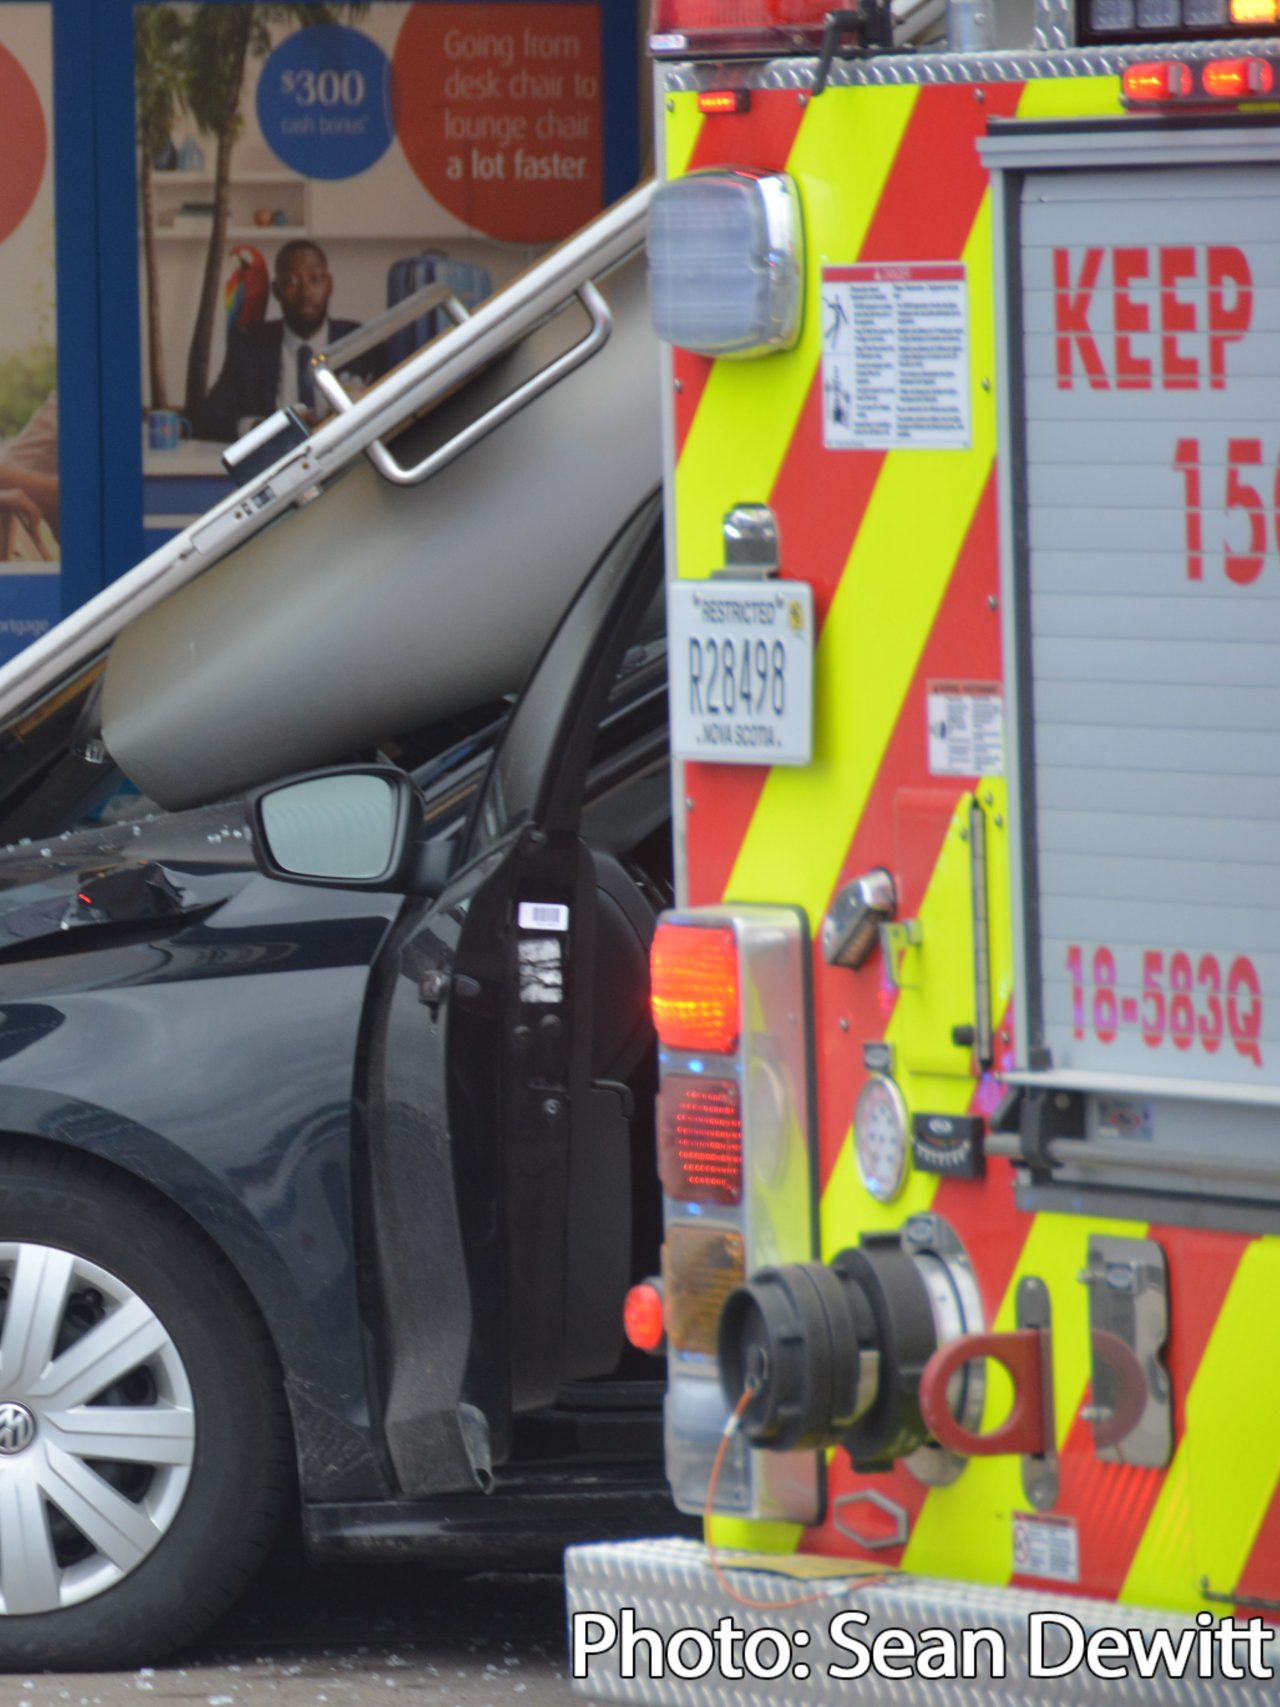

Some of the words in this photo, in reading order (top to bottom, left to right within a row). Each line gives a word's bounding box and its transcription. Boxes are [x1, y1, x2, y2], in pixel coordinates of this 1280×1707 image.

[444, 31, 514, 66] Going
[524, 29, 580, 57] from
[281, 69, 365, 107] $300
[445, 69, 499, 100] desk
[509, 69, 565, 100] chair
[576, 73, 598, 100] to
[445, 108, 527, 147] lounge
[535, 109, 591, 140] chair
[447, 155, 463, 179] a
[472, 149, 504, 179] lot
[1053, 246, 1253, 391] KEEP
[1172, 437, 1280, 586] 15
[701, 599, 775, 625] RESTRICTED
[688, 636, 786, 717] R28498
[703, 722, 732, 745] NOVA
[735, 722, 774, 747] SCOTIA
[1066, 943, 1264, 1069] 18-583Q
